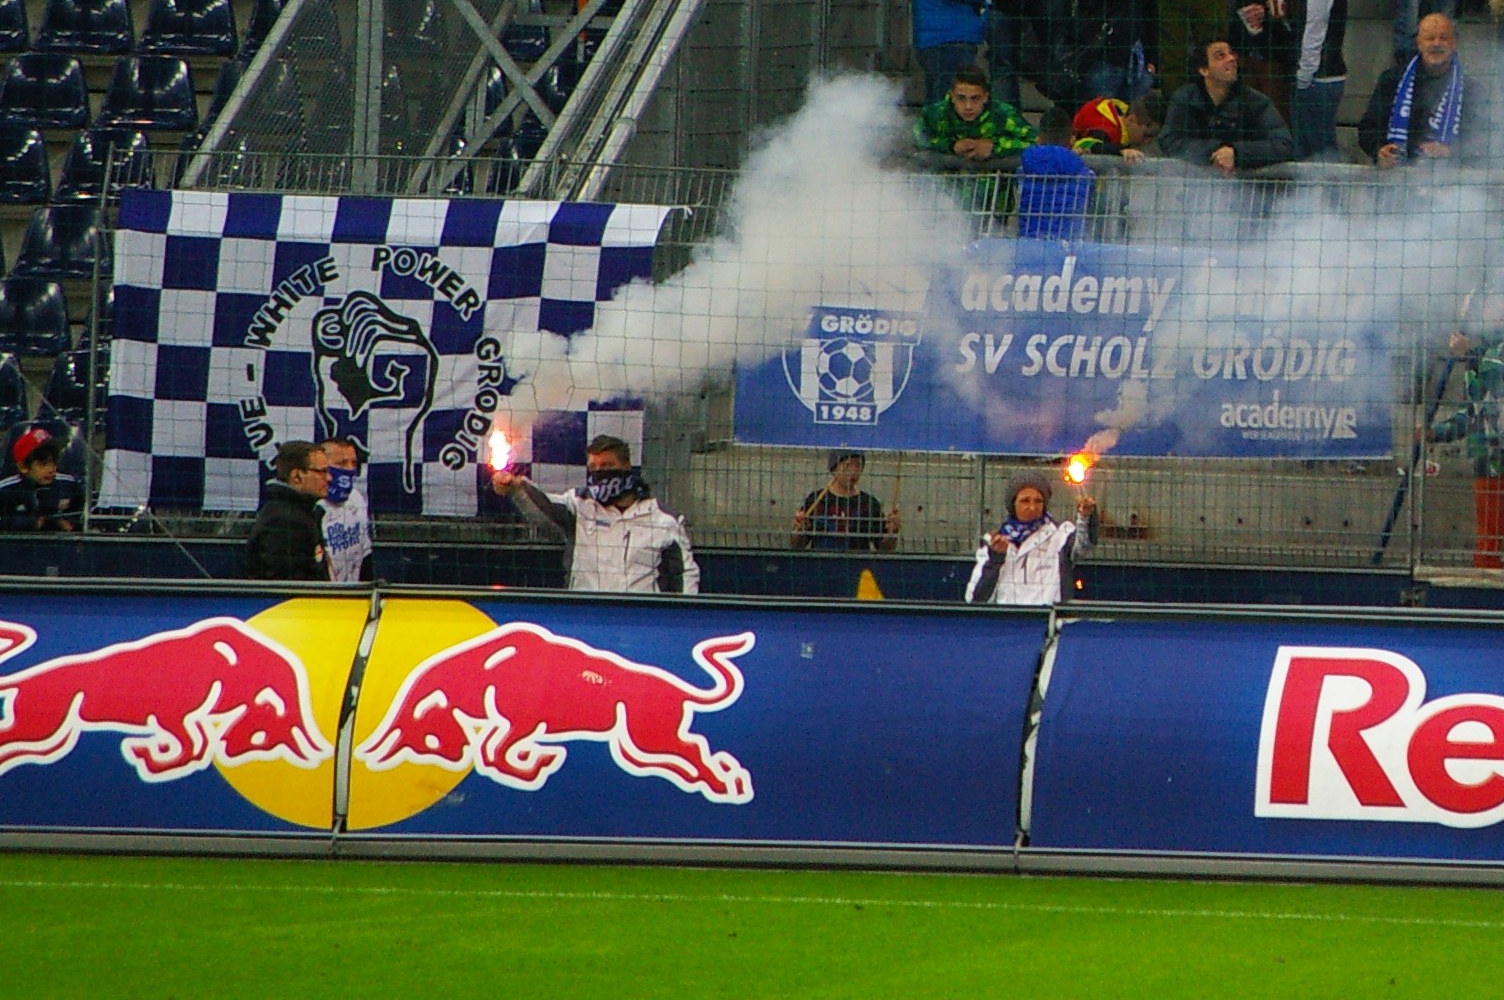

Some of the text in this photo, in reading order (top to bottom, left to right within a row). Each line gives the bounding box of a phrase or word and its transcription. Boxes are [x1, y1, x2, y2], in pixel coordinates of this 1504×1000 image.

[243, 256, 340, 348] WHITE
[371, 246, 481, 322] POWER
[961, 255, 1176, 332] academy
[820, 313, 917, 337] GRÖDIG
[955, 332, 1014, 375] SV
[1192, 326, 1357, 383] GRÖDIG
[819, 405, 872, 422] 1948
[1219, 389, 1337, 439] academy
